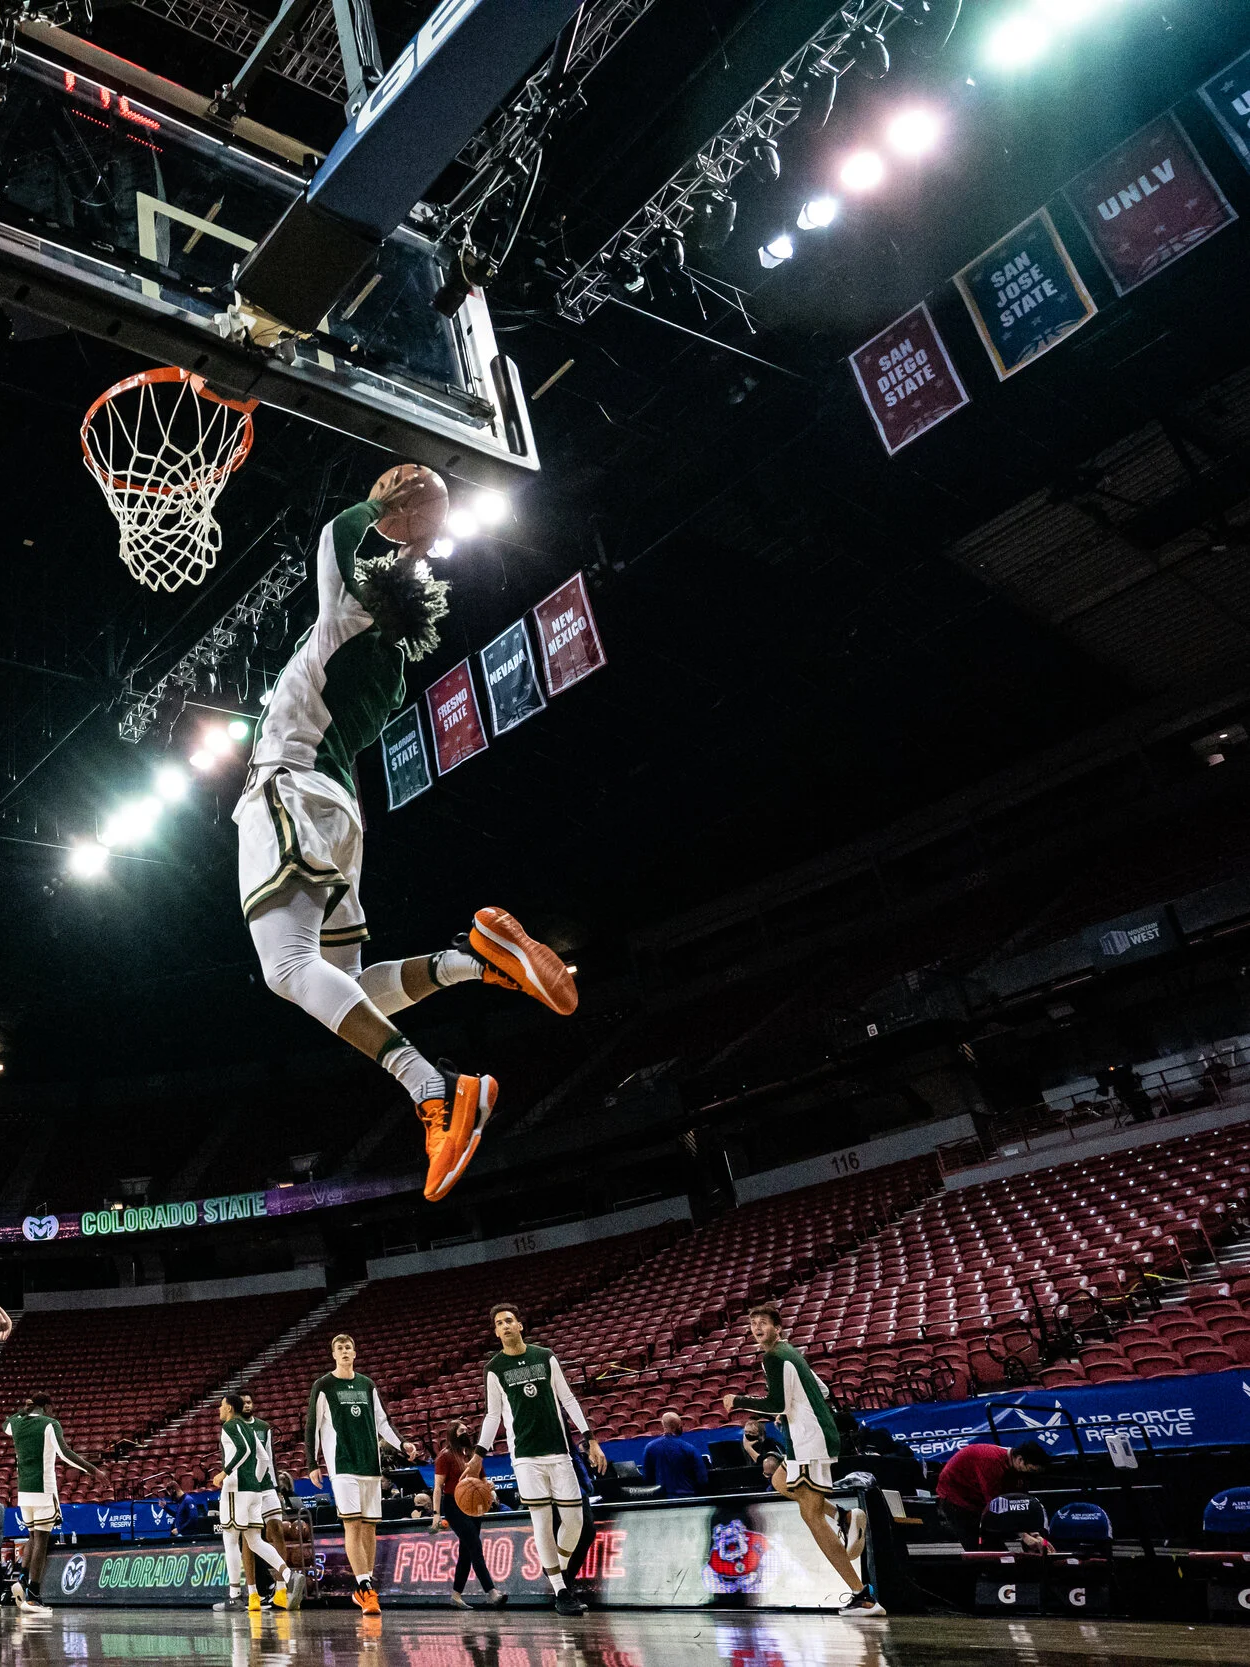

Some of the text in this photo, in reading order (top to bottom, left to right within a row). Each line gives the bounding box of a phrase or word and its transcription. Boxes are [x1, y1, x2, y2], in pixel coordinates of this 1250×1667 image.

[1097, 158, 1176, 221] UNLV
[990, 251, 1031, 289] SAN
[996, 268, 1044, 308] JOSE
[1000, 279, 1058, 328] STATE
[877, 349, 930, 395] DIEGO
[878, 339, 915, 372] SAN
[884, 363, 937, 408] STATE
[547, 616, 588, 657] MEXICO
[551, 607, 574, 634] NEW
[489, 649, 528, 686] NEVADA
[437, 688, 468, 722] FRESNO
[443, 707, 468, 732] STATE
[391, 741, 419, 772] STATE
[1130, 928, 1160, 944] WEST
[831, 1152, 861, 1174] 116
[81, 1191, 268, 1236] COLORADO STATE
[514, 1235, 538, 1254] 115
[1086, 1422, 1193, 1442] RESERVE
[1117, 1408, 1195, 1426] FORCE
[909, 1439, 969, 1453] SERVE
[98, 1554, 189, 1588] COLORADO
[997, 1584, 1017, 1604] G
[1068, 1588, 1086, 1606] G
